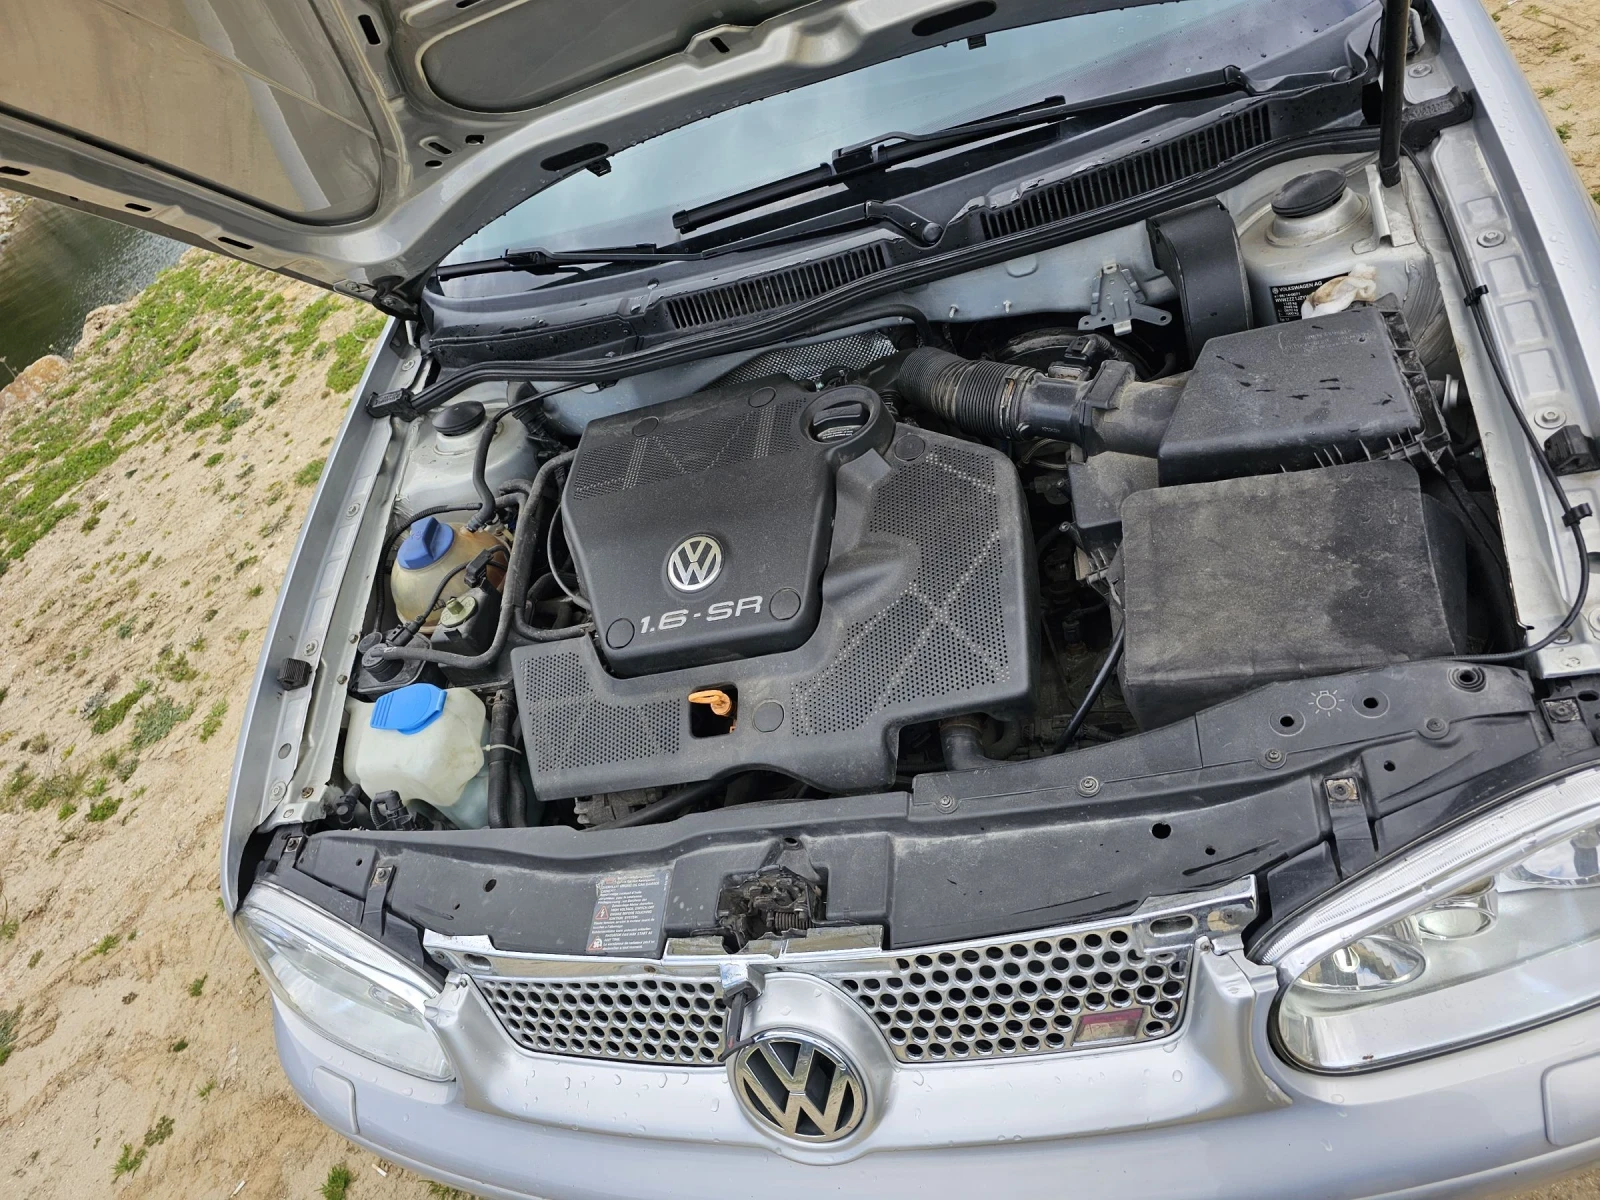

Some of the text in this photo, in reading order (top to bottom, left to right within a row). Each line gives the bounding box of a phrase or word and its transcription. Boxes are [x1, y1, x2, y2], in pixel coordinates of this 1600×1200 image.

[1279, 282, 1313, 291] VOLKSWAGEN
[667, 535, 722, 590] VW
[736, 1031, 865, 1143] VW
